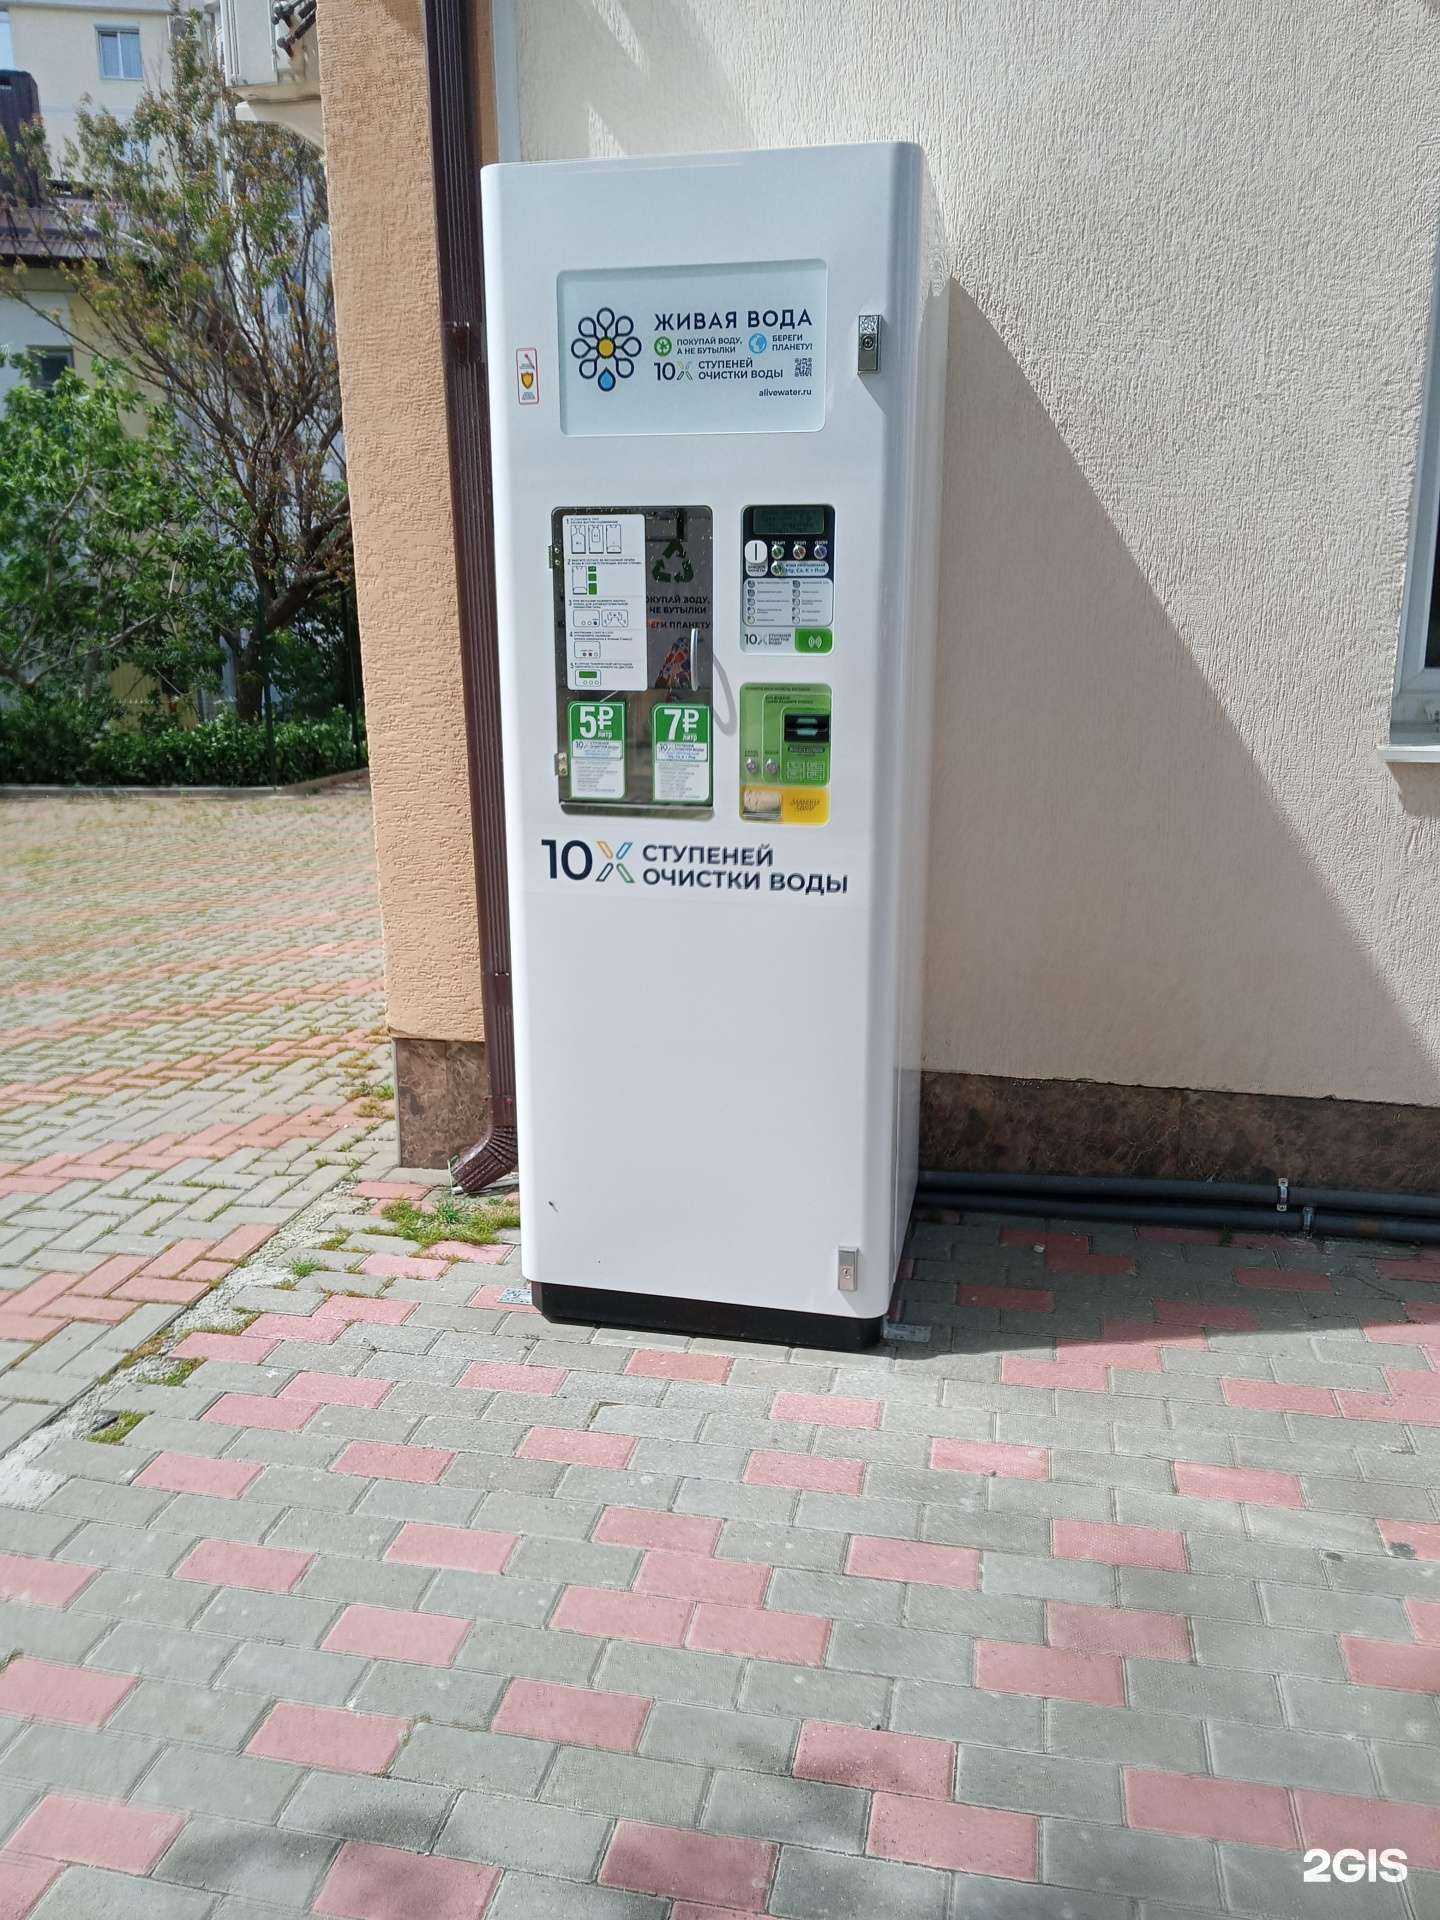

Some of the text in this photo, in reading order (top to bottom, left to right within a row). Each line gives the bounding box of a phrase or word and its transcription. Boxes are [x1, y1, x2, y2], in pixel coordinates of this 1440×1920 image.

[654, 309, 813, 331] ЖИВАЯ ВОДА
[676, 337, 716, 346] ПОКУПАЙ
[772, 334, 803, 342] БЕРЕГИ
[697, 346, 736, 354] БУТЫЛКИ
[698, 357, 753, 369] СТУПЕНЕЙ
[698, 369, 784, 380] ОЧИСТКИ ВОДЫ
[759, 388, 812, 397] alivewater.ru
[643, 843, 774, 867] СТУПЕНЕЙ
[643, 868, 848, 896] ОЧИСТКИ ВОДЫ
